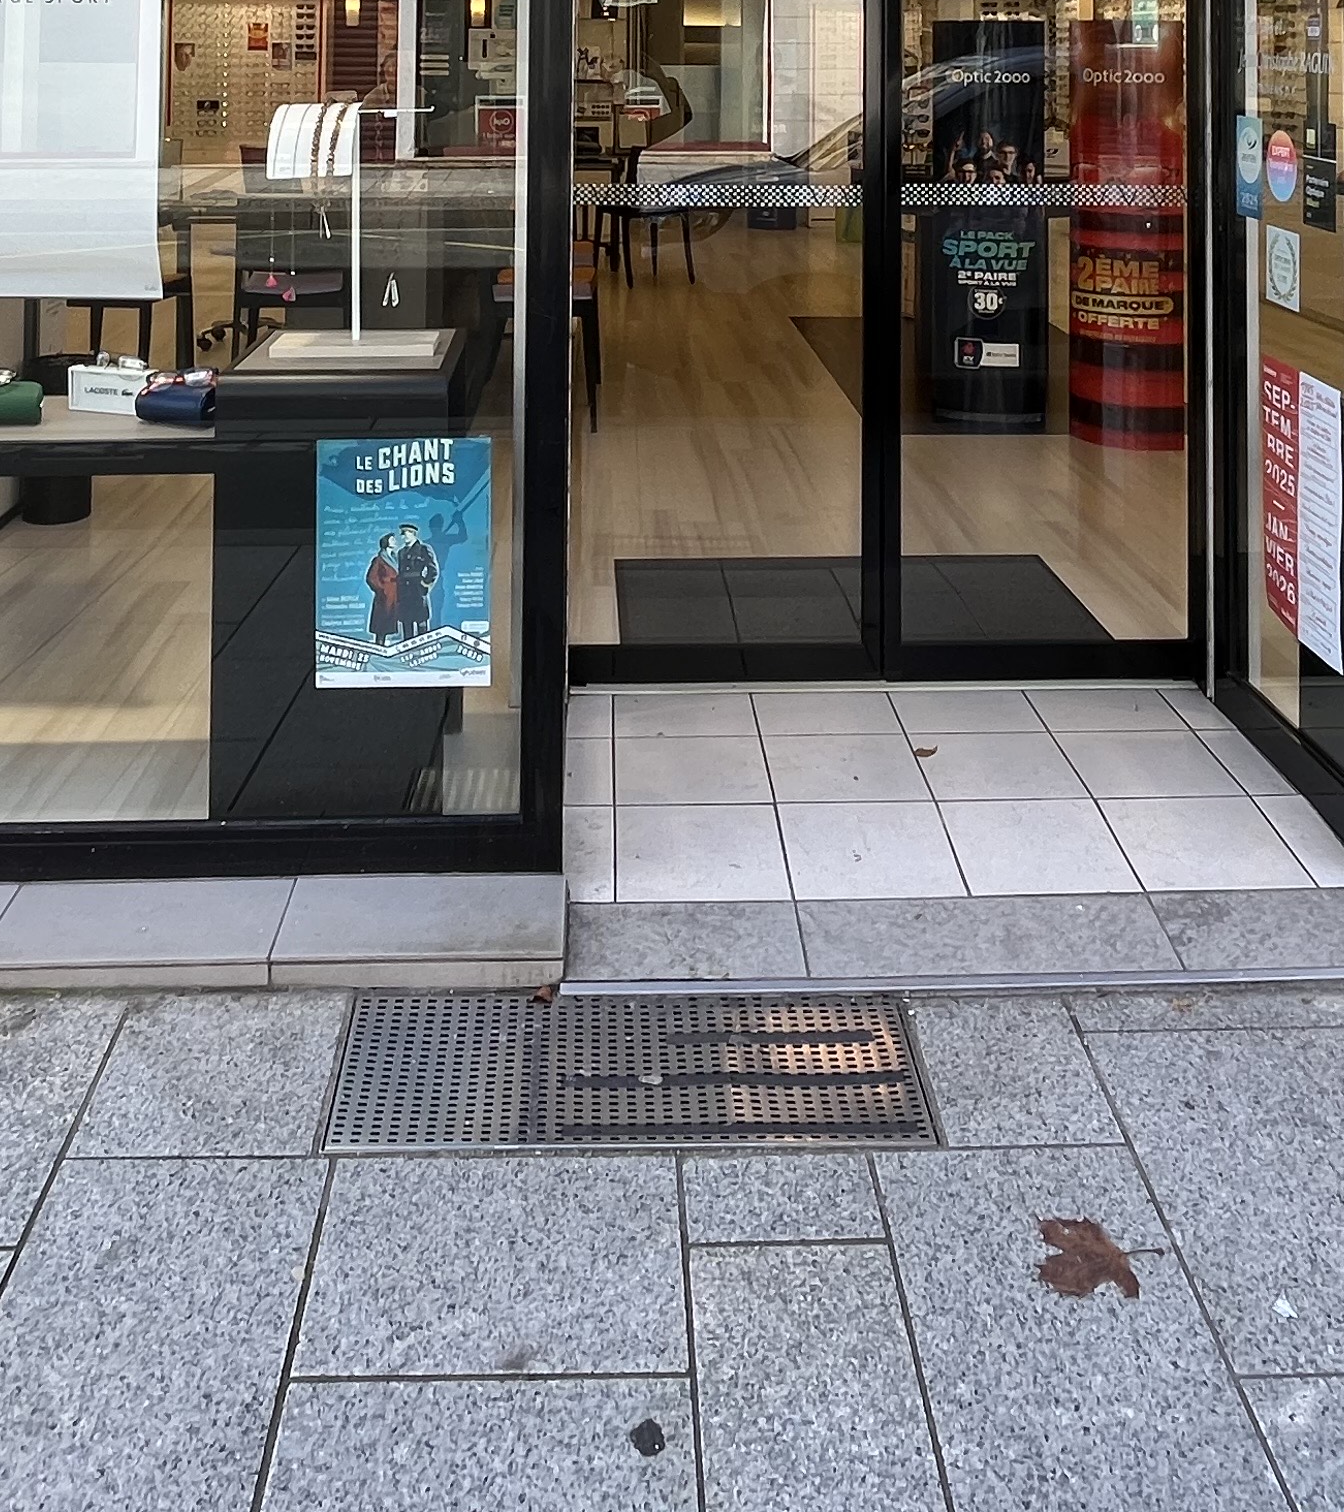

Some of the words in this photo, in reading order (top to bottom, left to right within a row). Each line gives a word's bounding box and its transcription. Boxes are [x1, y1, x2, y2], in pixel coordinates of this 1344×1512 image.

[952, 67, 992, 87] Optic
[994, 69, 1031, 84] 2000
[1082, 67, 1122, 87] Optic
[1123, 69, 1165, 84] 2000
[960, 230, 976, 240] LE
[976, 231, 1014, 240] PACK
[942, 239, 1036, 258] SPORT
[964, 258, 988, 270] LA
[991, 259, 1029, 271] VUE
[974, 271, 1017, 281] PAIRE
[1075, 295, 1090, 306] DE
[1091, 298, 1165, 312] MARQUE
[1077, 311, 1160, 330] OFFERTE
[83, 387, 119, 397] LACOSTE
[356, 455, 373, 471] LE
[378, 438, 454, 470] CHANT
[356, 478, 383, 494] DES
[387, 462, 455, 492] LIONS
[319, 643, 354, 660] MARDI
